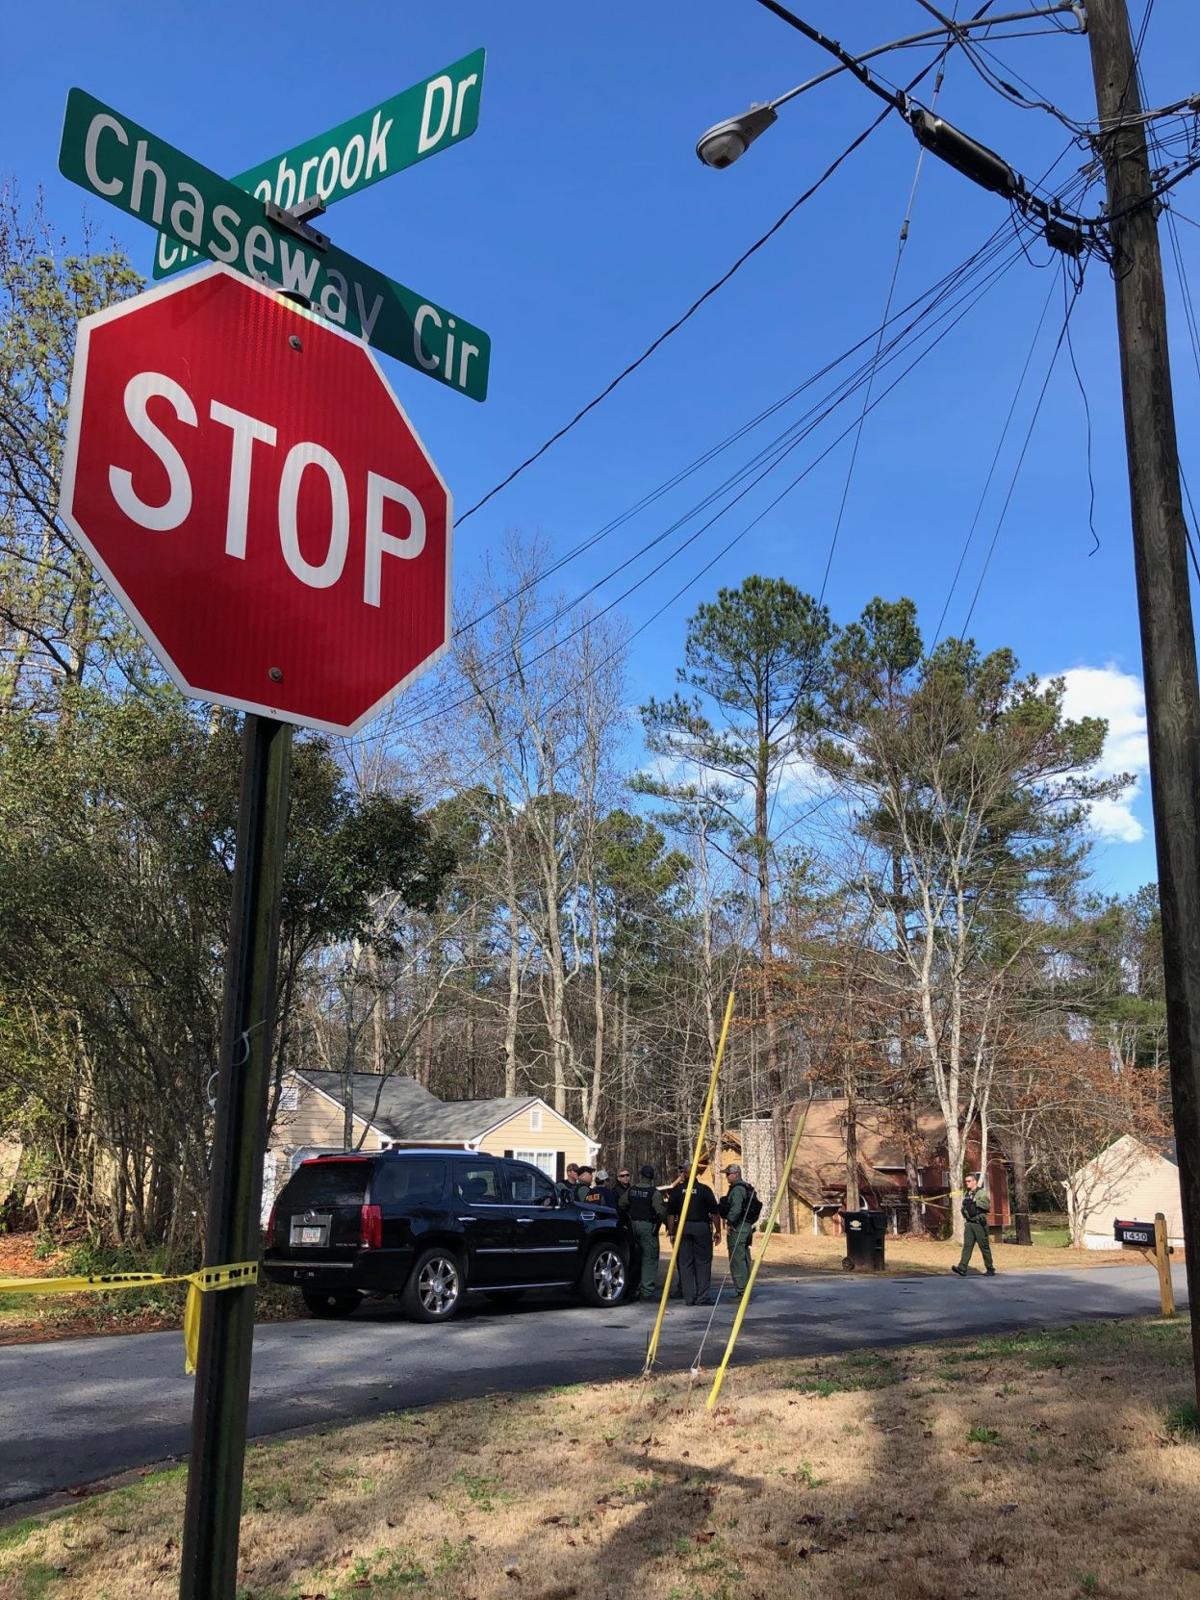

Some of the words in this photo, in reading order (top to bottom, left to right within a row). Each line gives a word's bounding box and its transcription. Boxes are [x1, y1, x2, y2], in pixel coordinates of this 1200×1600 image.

[84, 112, 383, 345] Chaseway
[413, 304, 479, 388] Cir
[157, 109, 394, 270] Cbrook
[417, 73, 478, 154] Dr
[108, 371, 427, 608] STOP
